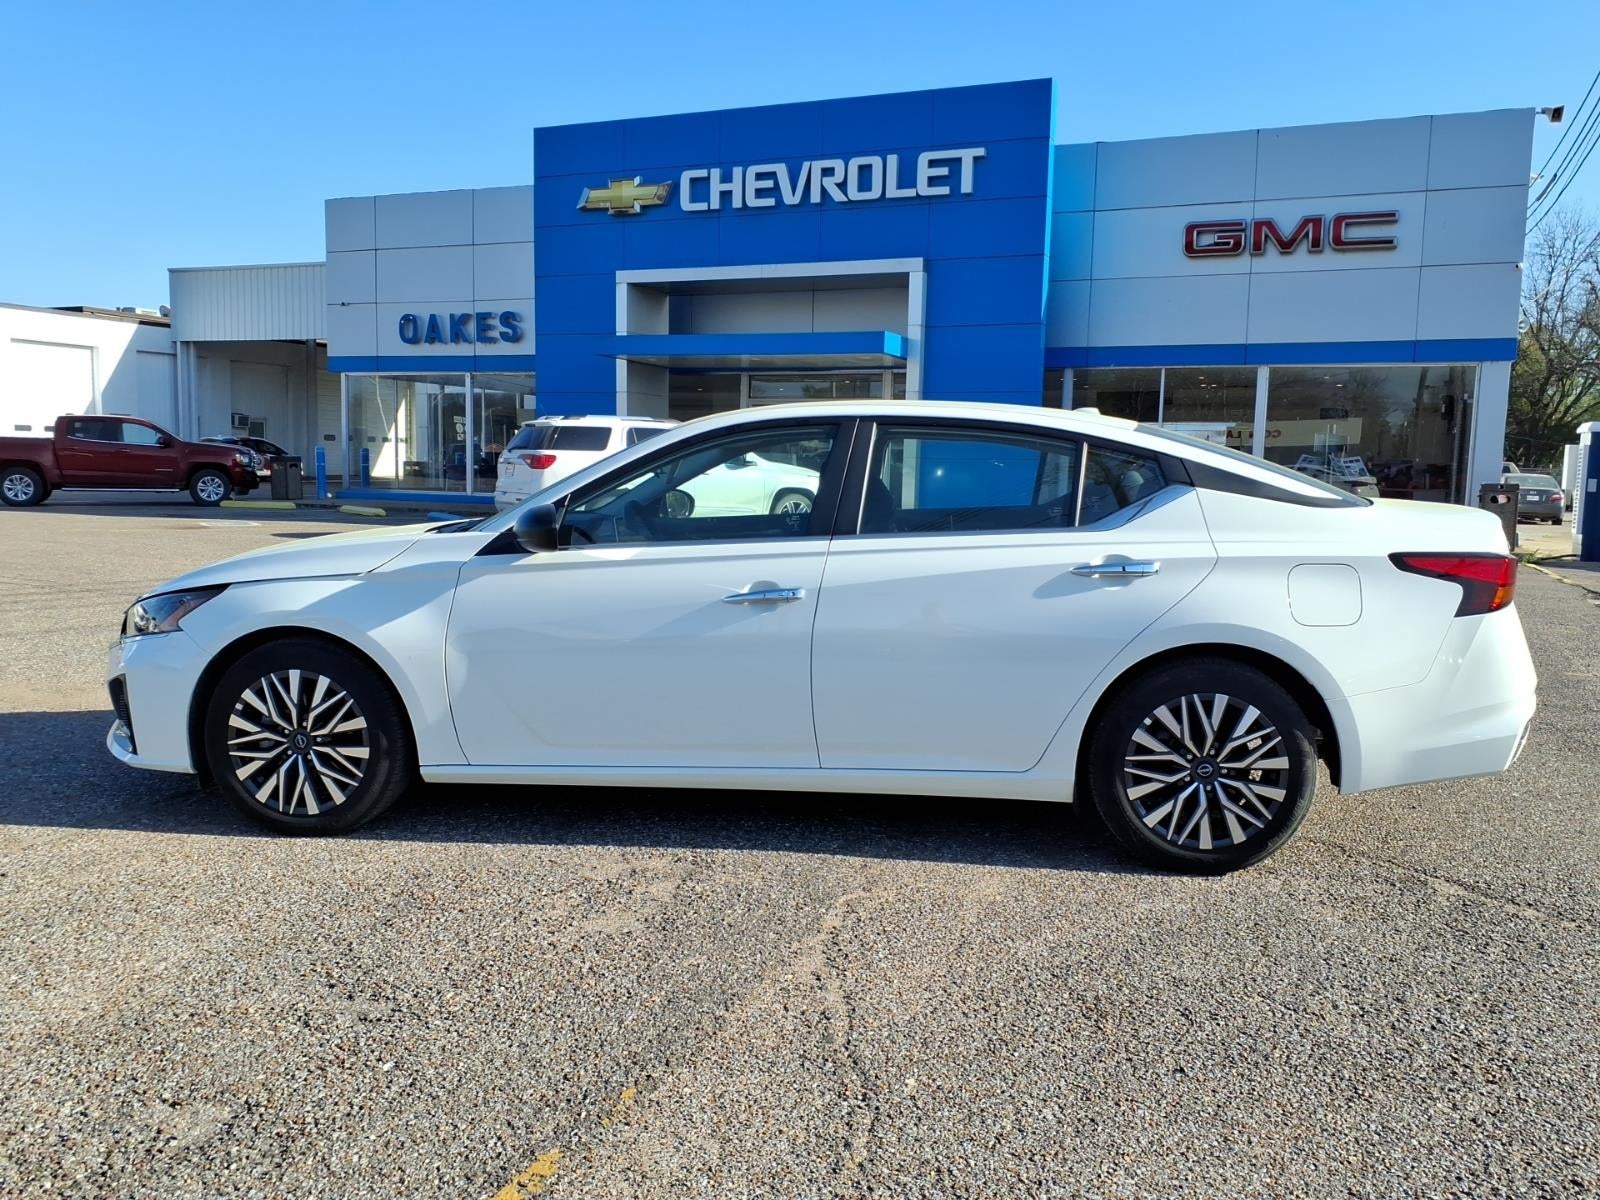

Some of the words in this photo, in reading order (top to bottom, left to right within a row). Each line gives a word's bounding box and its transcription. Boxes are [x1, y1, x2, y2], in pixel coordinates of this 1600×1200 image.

[680, 147, 986, 212] CHEVROLET
[1184, 210, 1399, 257] GMC
[399, 311, 523, 345] OAKES
